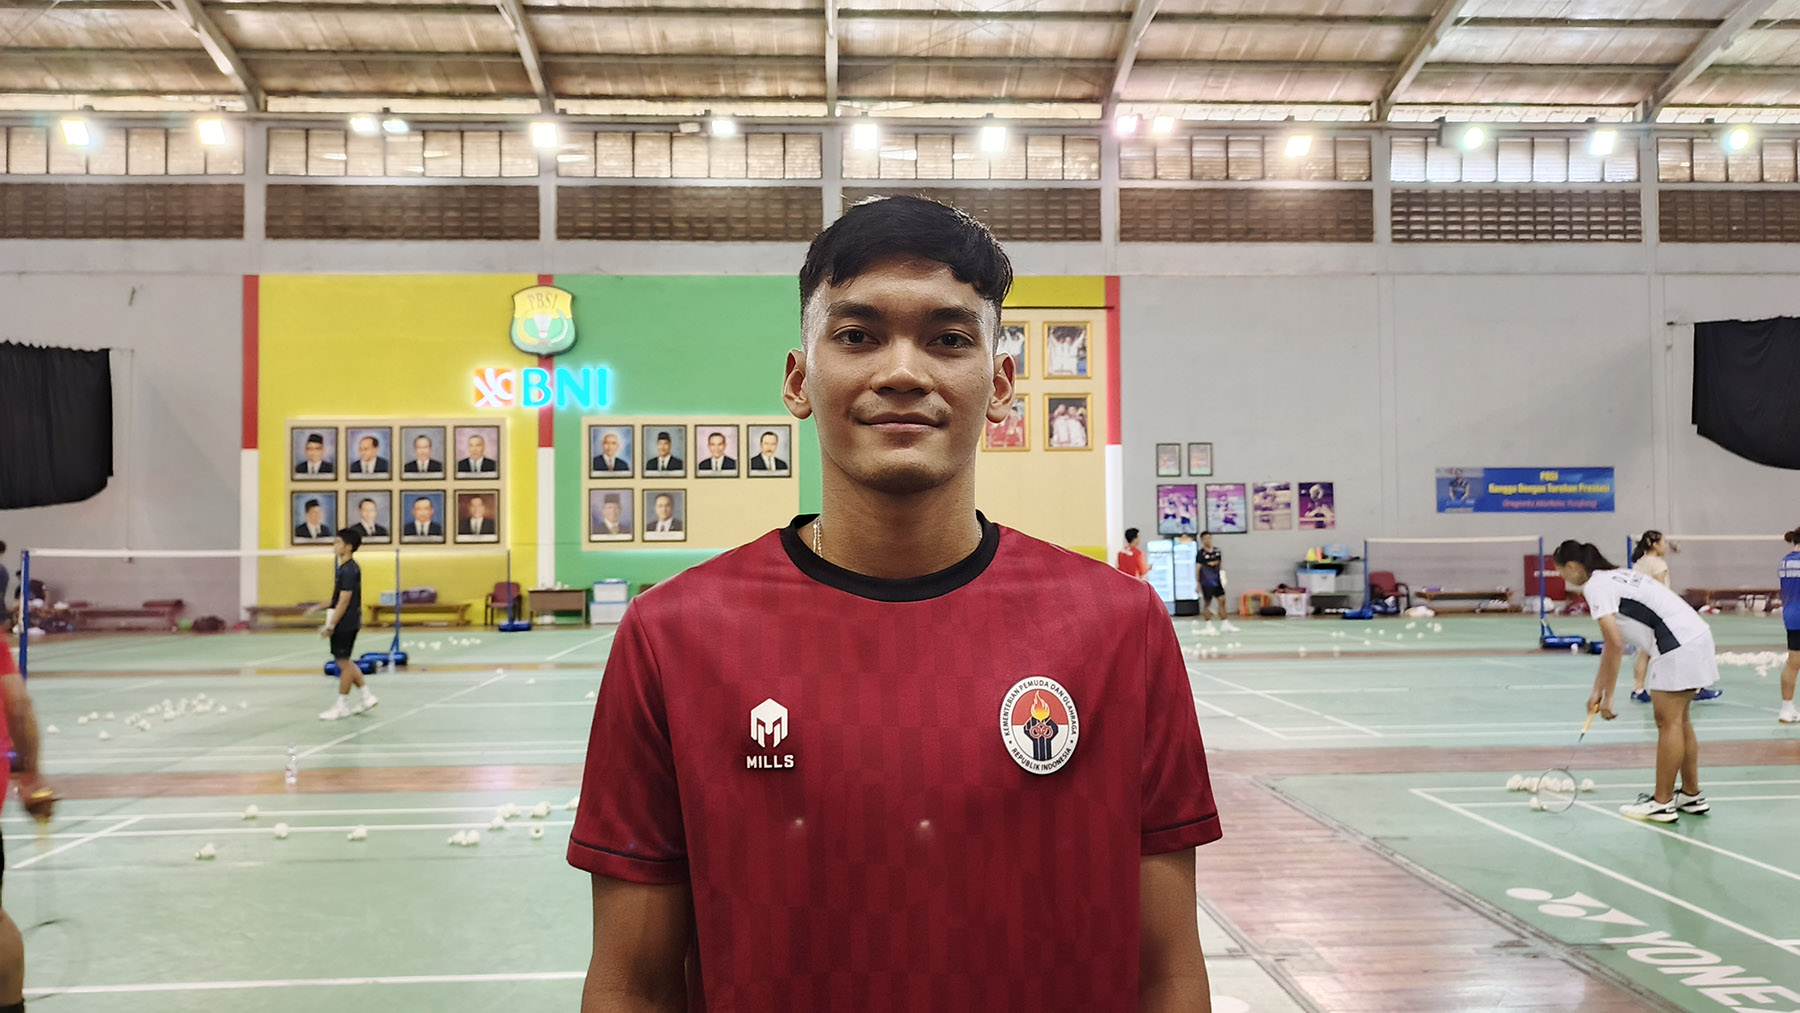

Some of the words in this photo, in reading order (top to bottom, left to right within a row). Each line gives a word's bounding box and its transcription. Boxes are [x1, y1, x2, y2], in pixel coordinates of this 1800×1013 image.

[527, 292, 559, 310] PBSI
[522, 367, 609, 408] BNI
[1002, 689, 1020, 737] KEMENTERIAN
[1019, 680, 1049, 691] PEMUDA
[1050, 683, 1064, 697] DAN
[1062, 695, 1077, 735] OLAHRAGA
[746, 754, 795, 769] MILLS
[1011, 747, 1040, 771] REPUBLIK
[1041, 747, 1072, 771] INDONESIA
[1600, 931, 1800, 1013] YONE
